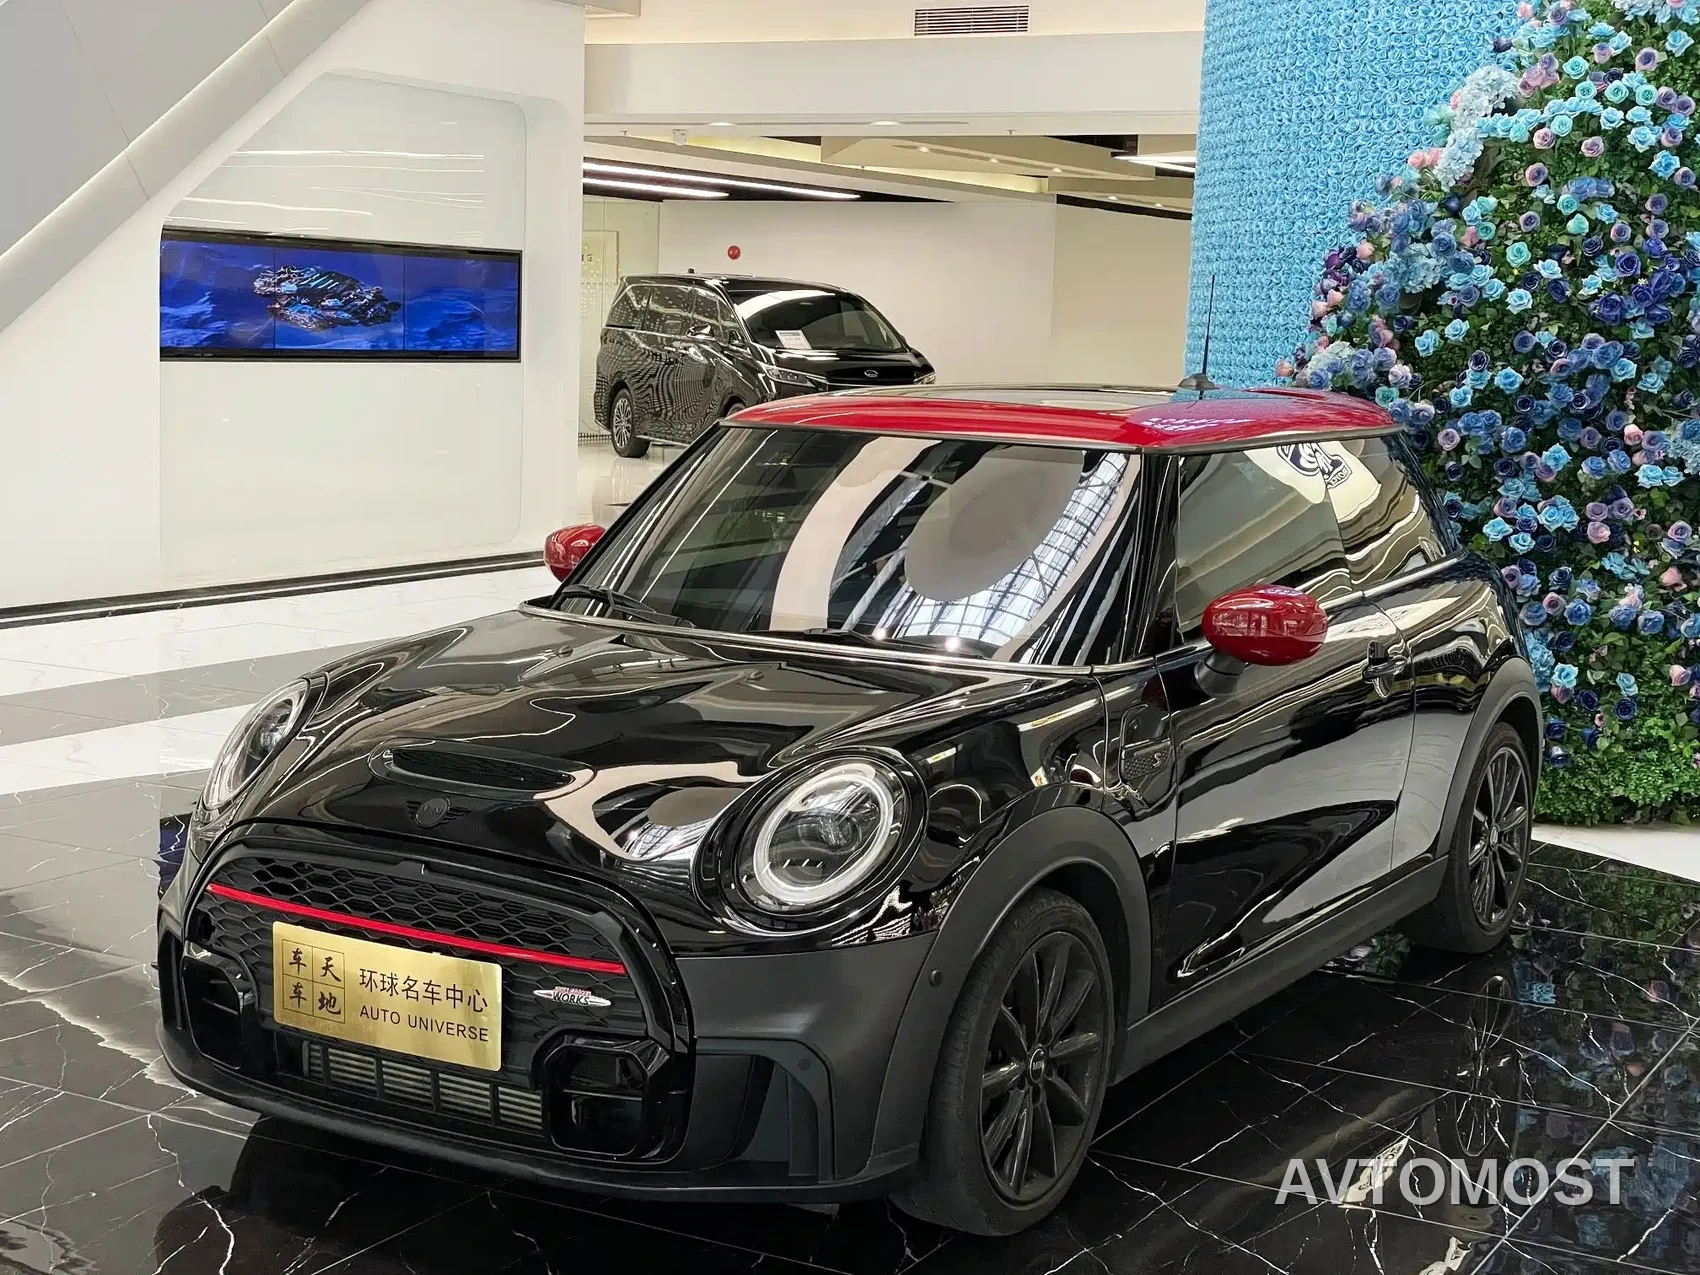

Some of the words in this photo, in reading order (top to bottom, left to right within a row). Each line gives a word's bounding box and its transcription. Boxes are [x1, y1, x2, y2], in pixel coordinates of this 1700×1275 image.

[359, 968, 488, 1013] 环球名车中心
[553, 991, 590, 1006] WORKS
[359, 1004, 401, 1025] AUTO
[408, 1014, 489, 1042] UNIVERSE
